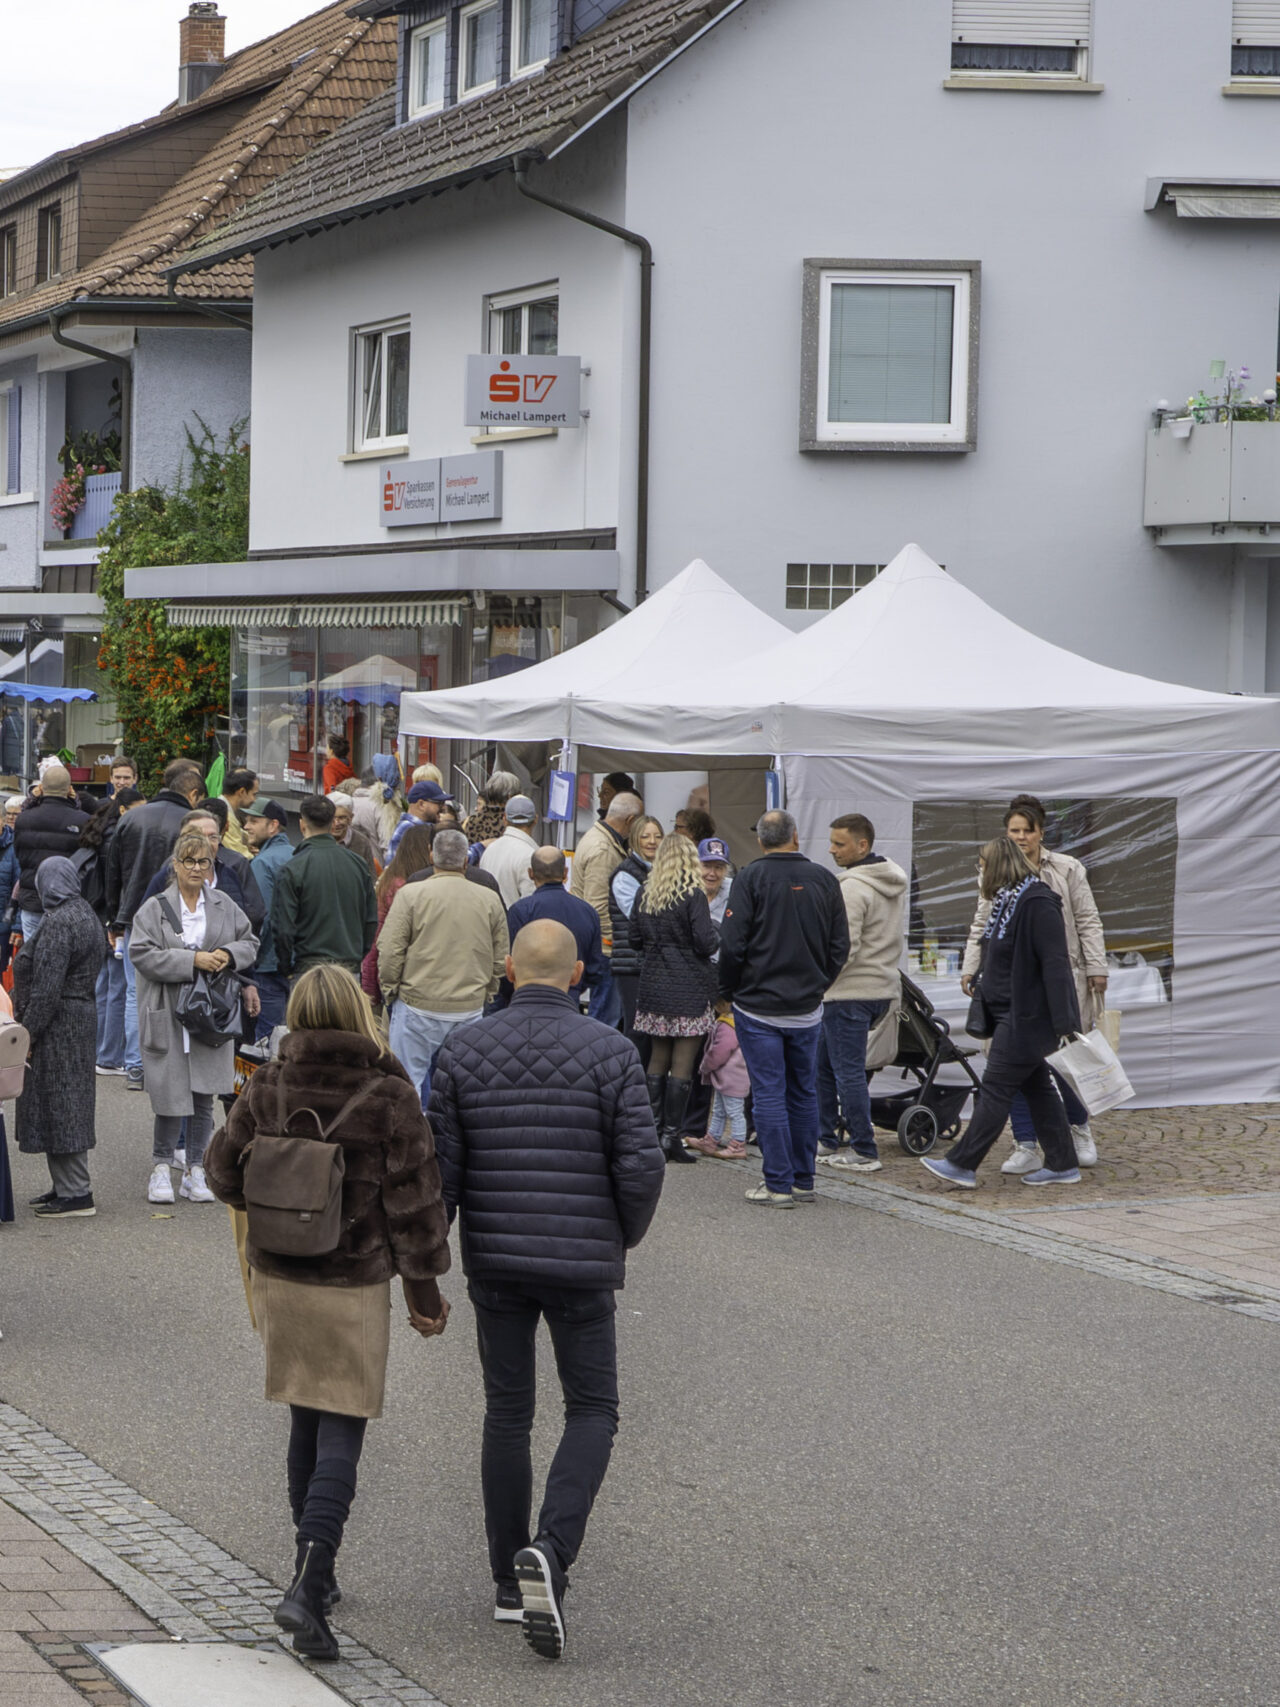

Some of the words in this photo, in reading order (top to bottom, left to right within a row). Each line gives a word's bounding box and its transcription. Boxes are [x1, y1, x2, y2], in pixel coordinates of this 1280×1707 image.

[480, 410, 520, 421] Michael
[523, 411, 567, 423] Lampert
[407, 480, 435, 496] Sparkassen
[446, 492, 466, 507] Michael
[467, 491, 490, 507] Lampert
